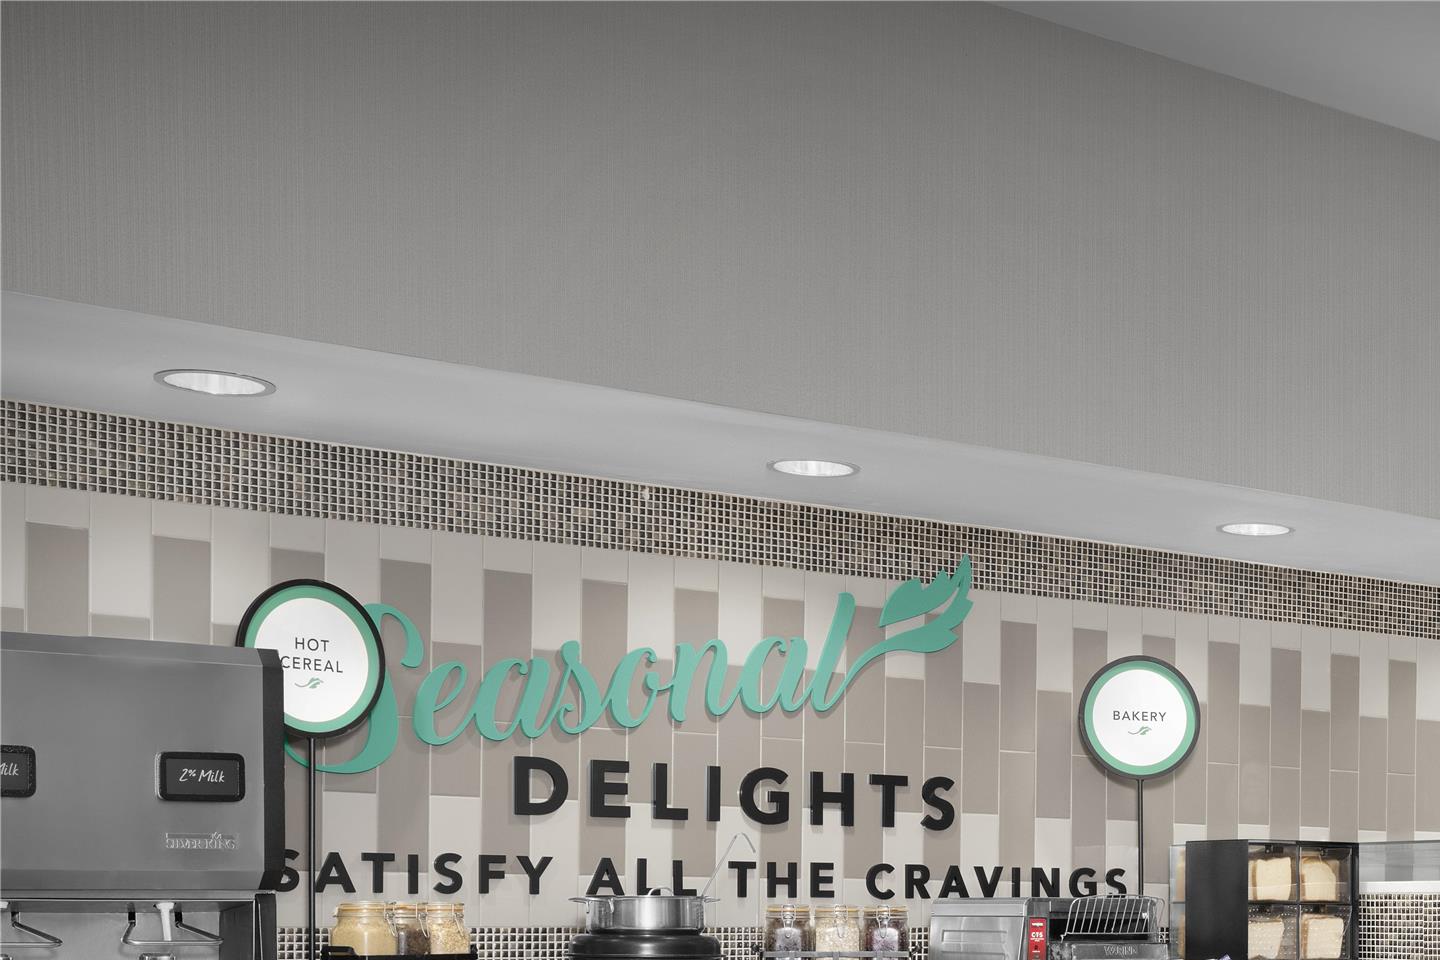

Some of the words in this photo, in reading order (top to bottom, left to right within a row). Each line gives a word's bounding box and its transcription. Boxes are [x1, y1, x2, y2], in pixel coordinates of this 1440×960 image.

[294, 637, 330, 652] HOT
[280, 656, 344, 673] CEREAL
[284, 592, 868, 774] Seasonal
[1112, 710, 1167, 722] BAKERY
[179, 768, 197, 782] 2%
[198, 769, 225, 783] Milk
[513, 755, 956, 832] DELIGHTS
[276, 849, 554, 895] SATISFY
[585, 857, 698, 897] ALL
[728, 861, 836, 898] THE
[865, 863, 1128, 900] CRAVINGS
